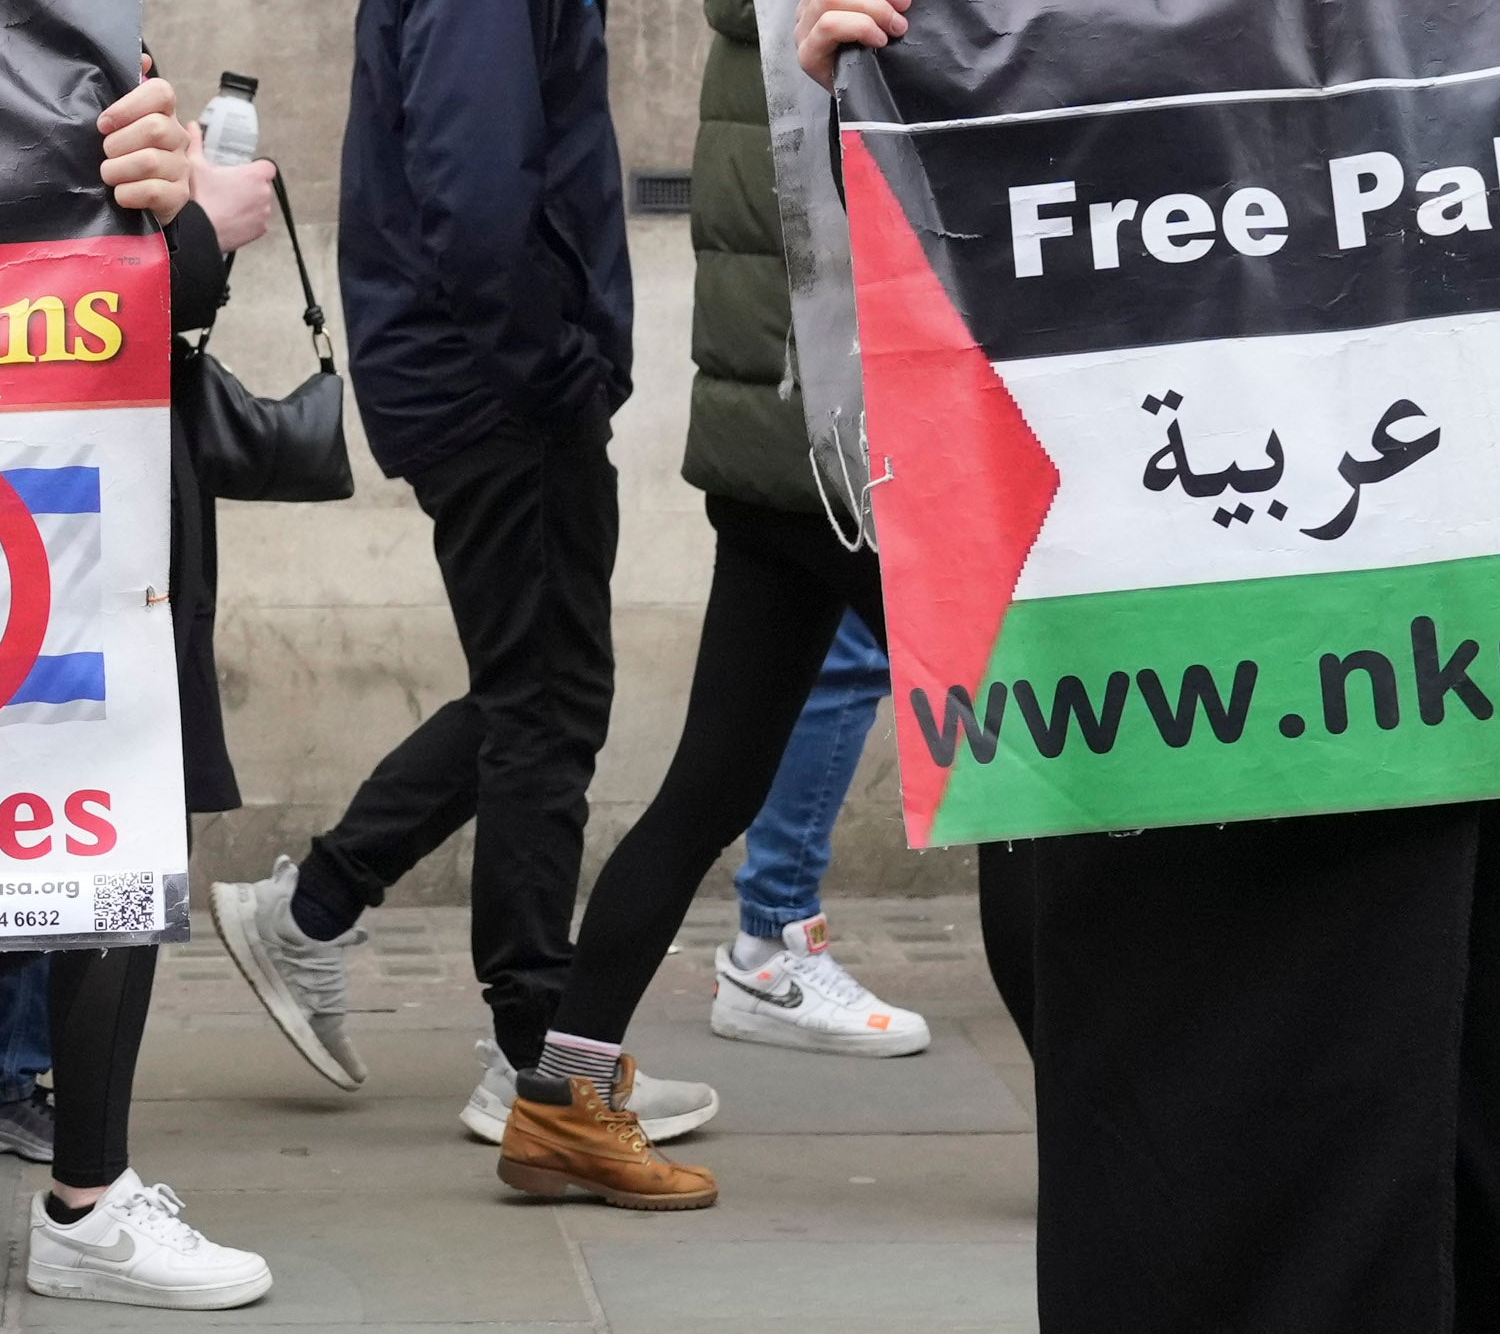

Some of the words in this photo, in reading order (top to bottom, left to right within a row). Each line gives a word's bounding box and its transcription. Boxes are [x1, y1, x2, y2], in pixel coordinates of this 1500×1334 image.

[1008, 180, 1289, 278] Free
[1141, 389, 1442, 541] عربية
[14, 909, 60, 928] 6632
